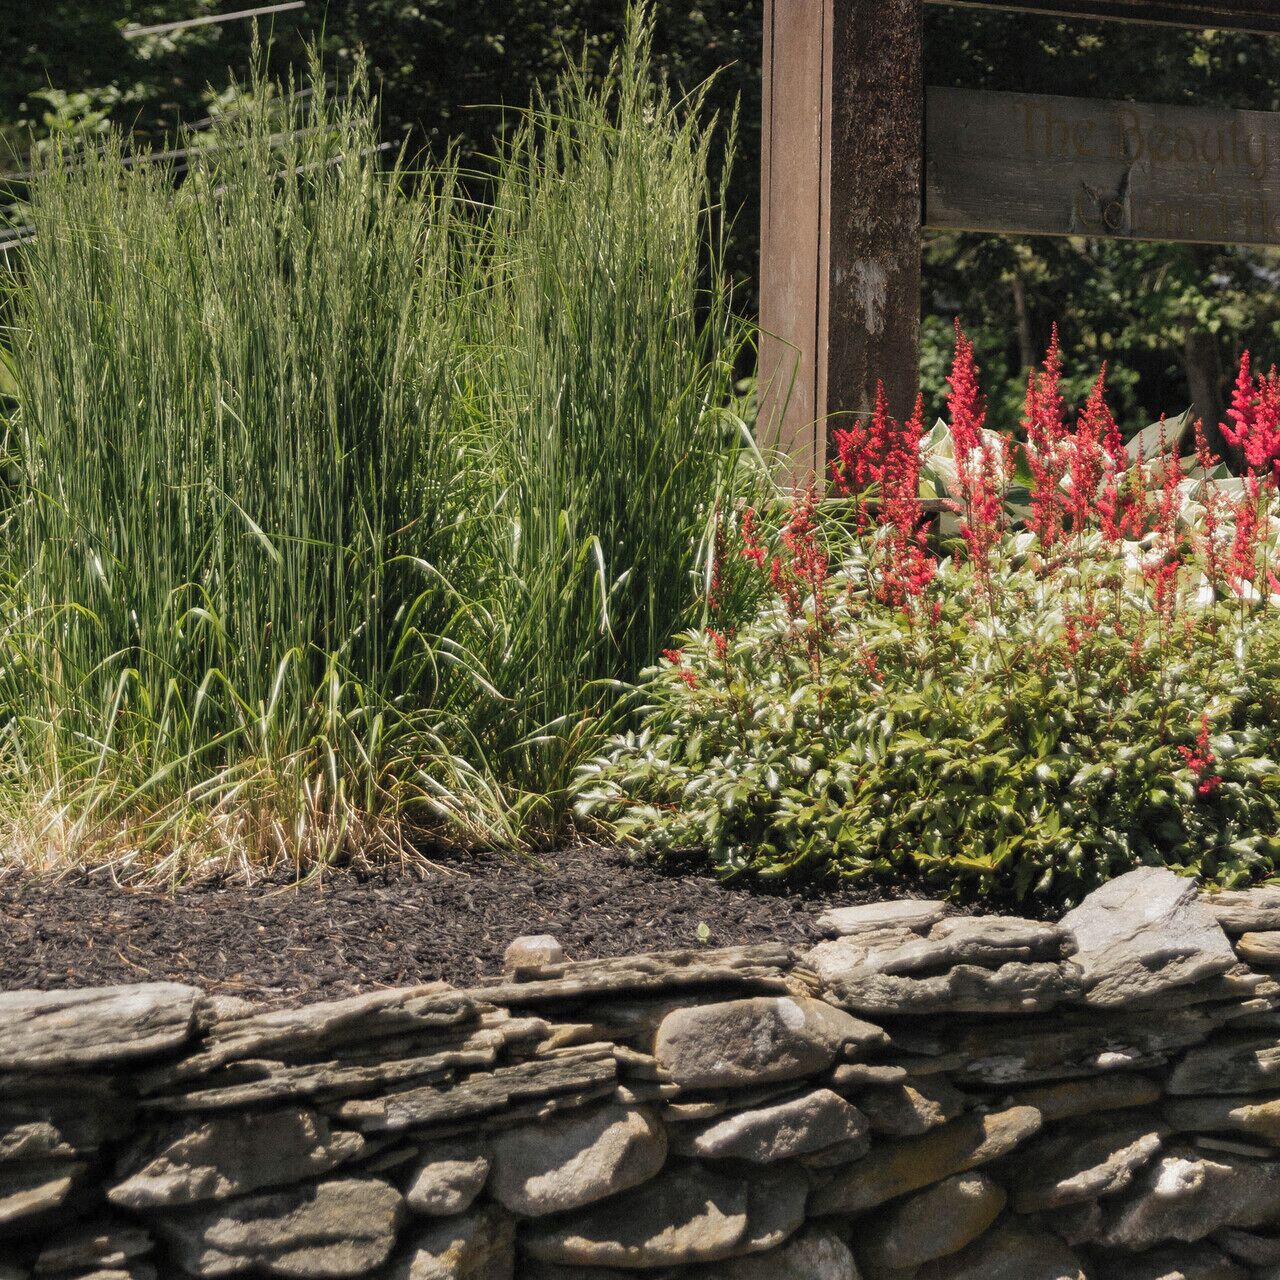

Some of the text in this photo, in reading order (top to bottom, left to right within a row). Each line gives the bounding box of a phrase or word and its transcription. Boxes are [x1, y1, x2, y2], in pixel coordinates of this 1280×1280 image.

[1016, 101, 1098, 158] The
[1112, 106, 1269, 180] Beauty
[1075, 188, 1228, 237] Colnial
